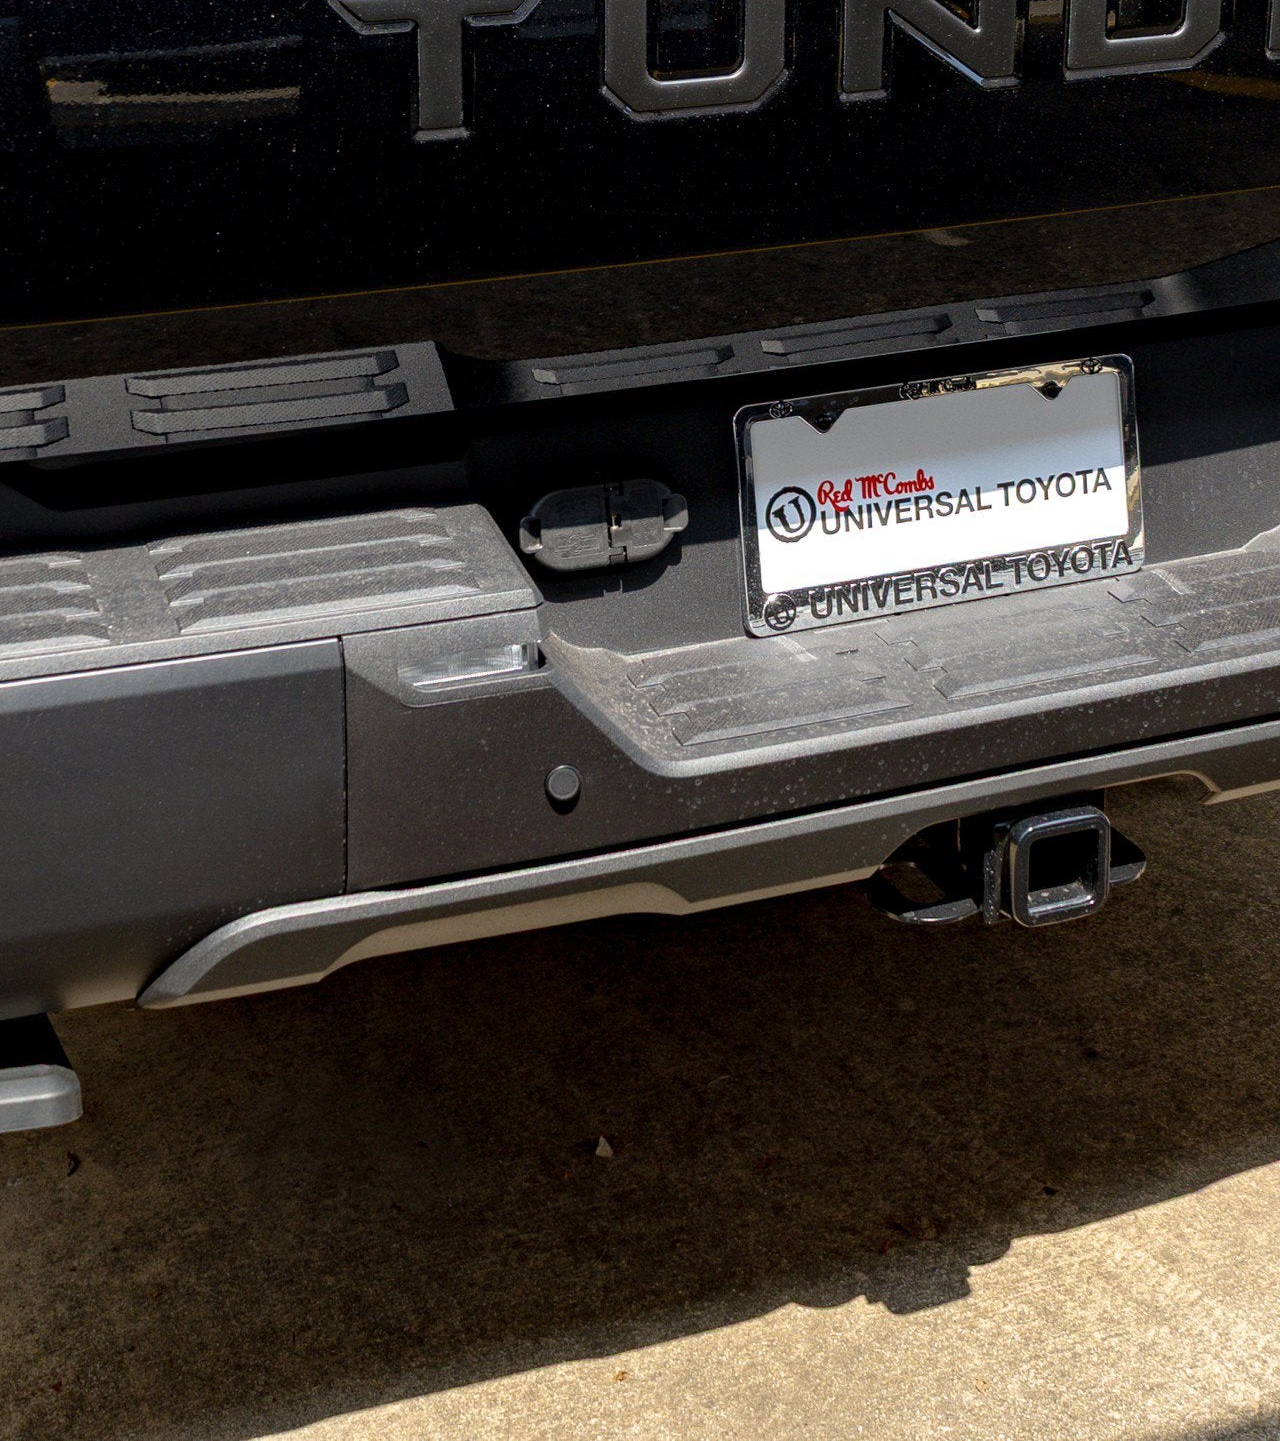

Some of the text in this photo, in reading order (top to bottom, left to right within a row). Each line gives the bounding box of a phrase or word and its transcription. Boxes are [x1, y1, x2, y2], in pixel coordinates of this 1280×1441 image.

[817, 469, 935, 513] Red McCombs
[821, 486, 992, 535] UNIVERSAL
[997, 467, 1112, 506] TOYOTA
[809, 560, 1003, 620] UNIVERSAL
[1006, 539, 1134, 585] TOYOTA
